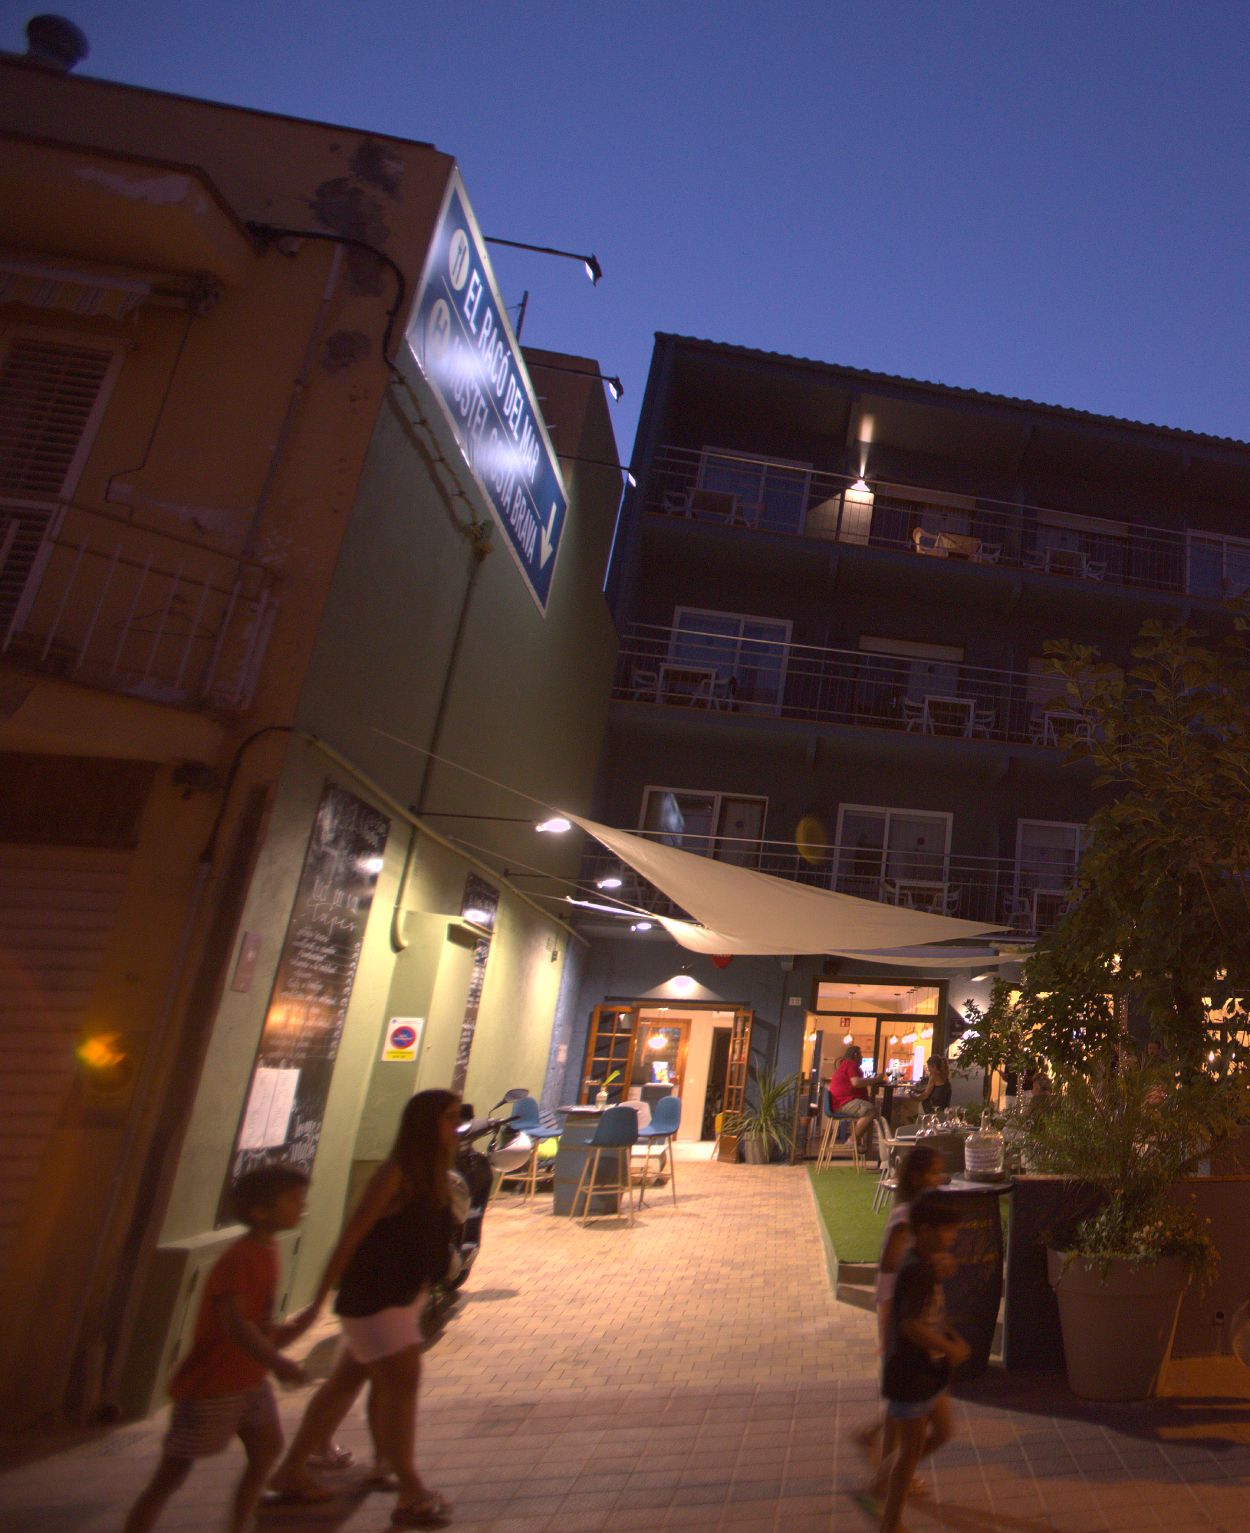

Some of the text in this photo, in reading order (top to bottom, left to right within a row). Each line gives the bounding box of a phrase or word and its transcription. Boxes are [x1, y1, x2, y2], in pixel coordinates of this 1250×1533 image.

[463, 267, 541, 484] EL RACÓ DEL MAR
[509, 484, 539, 565] BRAVA
